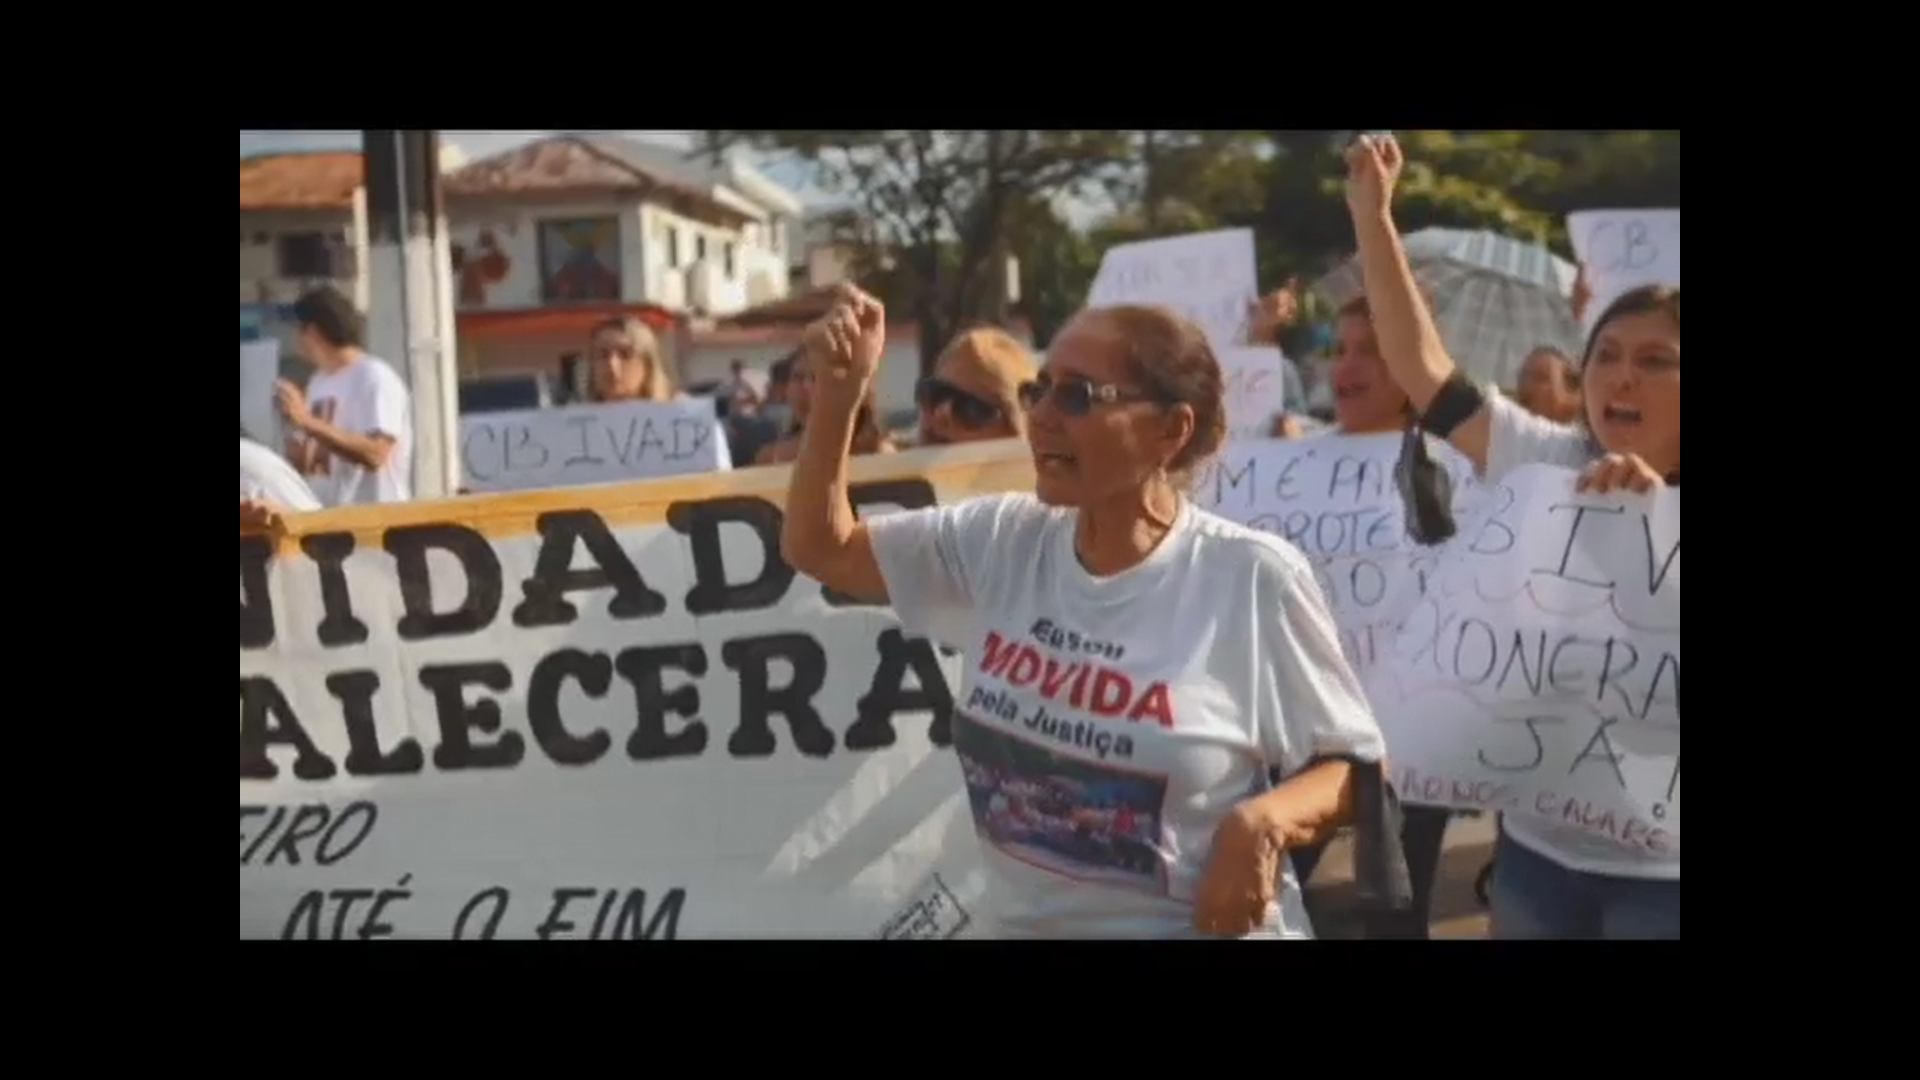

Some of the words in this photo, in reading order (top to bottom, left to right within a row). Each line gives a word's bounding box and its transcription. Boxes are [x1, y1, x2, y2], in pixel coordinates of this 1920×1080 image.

[1586, 218, 1660, 272] CB
[465, 421, 549, 481] CB
[240, 477, 937, 649] IDAD
[979, 630, 1175, 730] MOVIDA
[968, 686, 1019, 721] pela
[1024, 706, 1136, 759] Justiça
